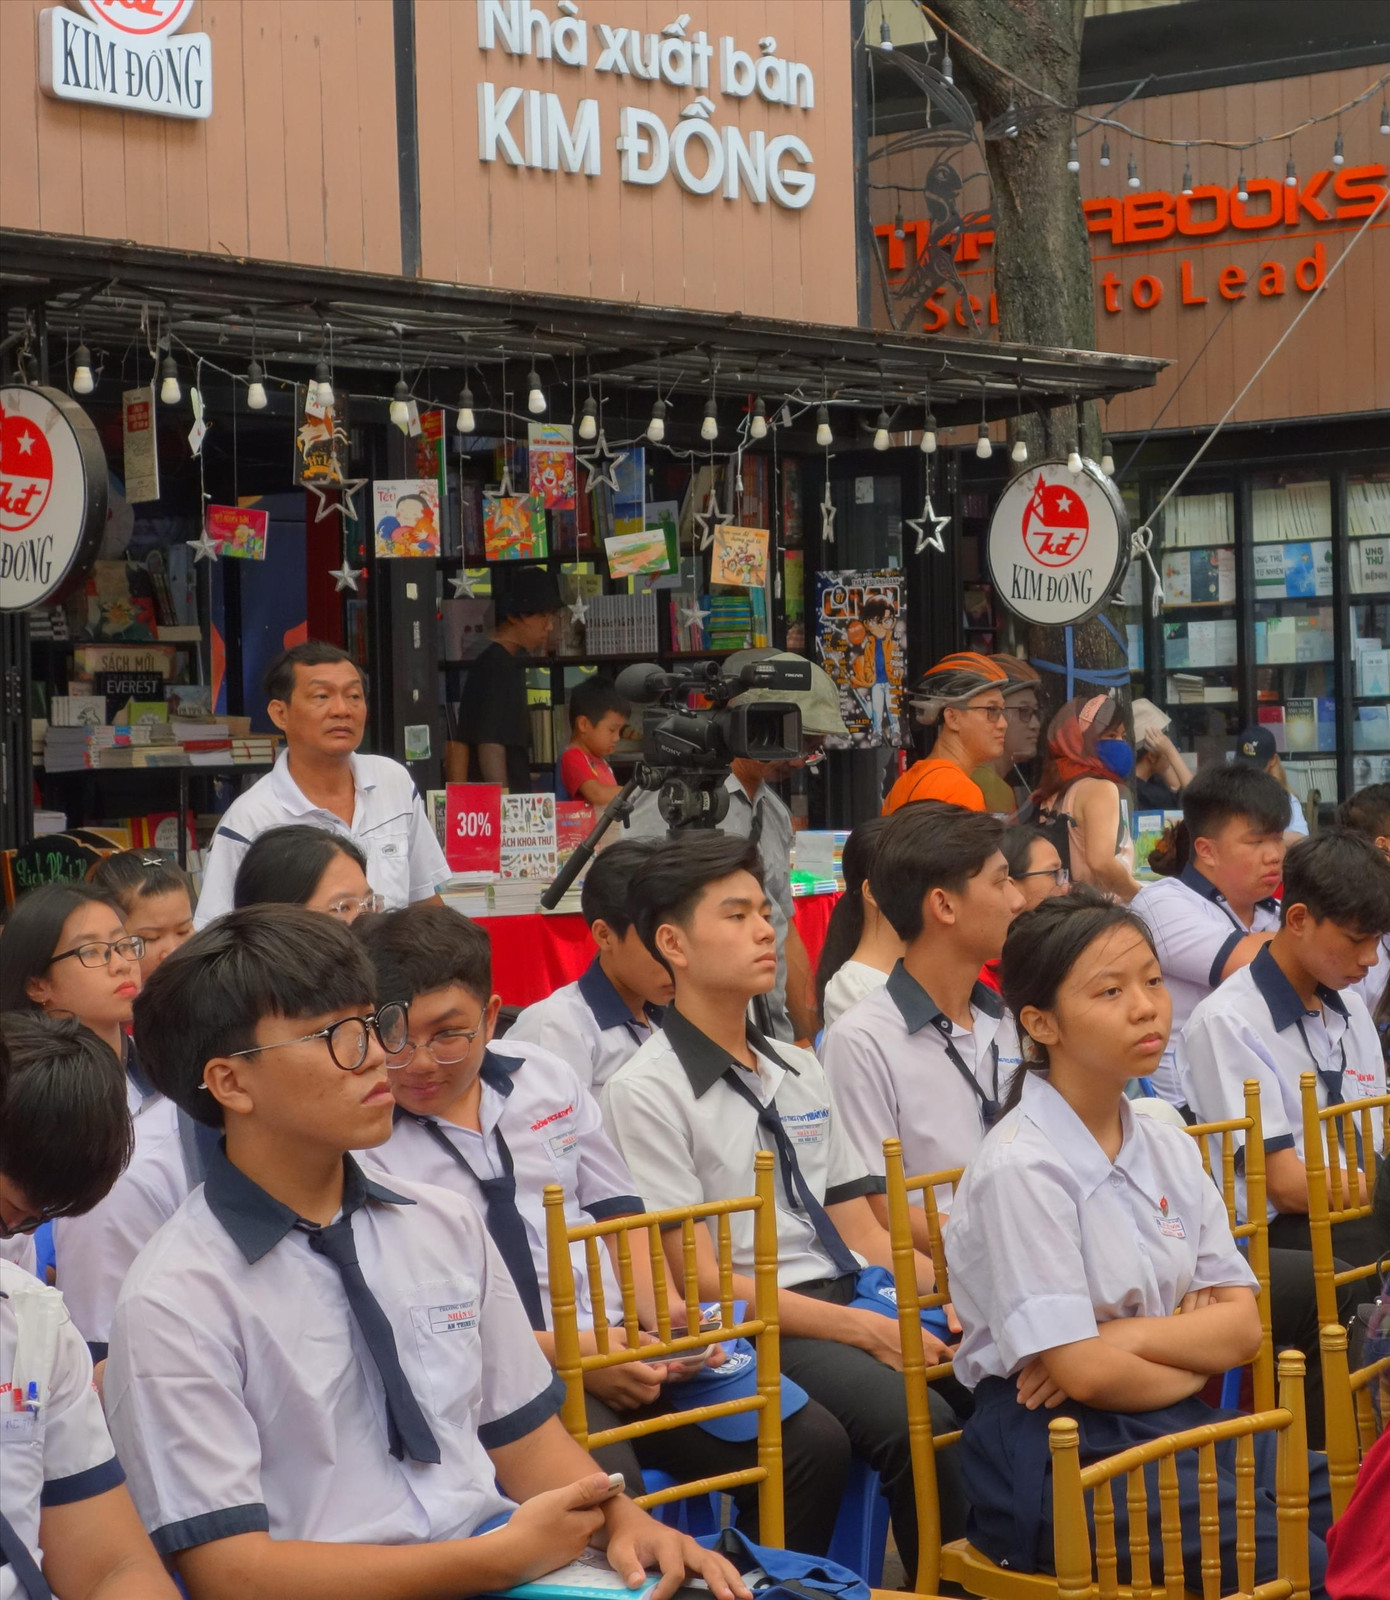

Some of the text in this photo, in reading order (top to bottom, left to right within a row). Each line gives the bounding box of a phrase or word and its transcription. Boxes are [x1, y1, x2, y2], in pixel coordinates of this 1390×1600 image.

[61, 17, 204, 110] KIM ĐỒNG
[477, 0, 815, 110] Nhà xuất bản
[477, 81, 816, 209] KIM ĐỒNG
[1101, 270, 1165, 313] to
[1180, 241, 1330, 306] Lead
[0, 534, 53, 585] ĐỒNG
[1011, 563, 1093, 605] KIM ĐỒNG
[101, 651, 130, 672] SÁCH
[106, 680, 158, 694] EVEREST
[661, 744, 682, 757] SONY
[456, 812, 492, 837] 30%
[517, 837, 537, 847] KHOA
